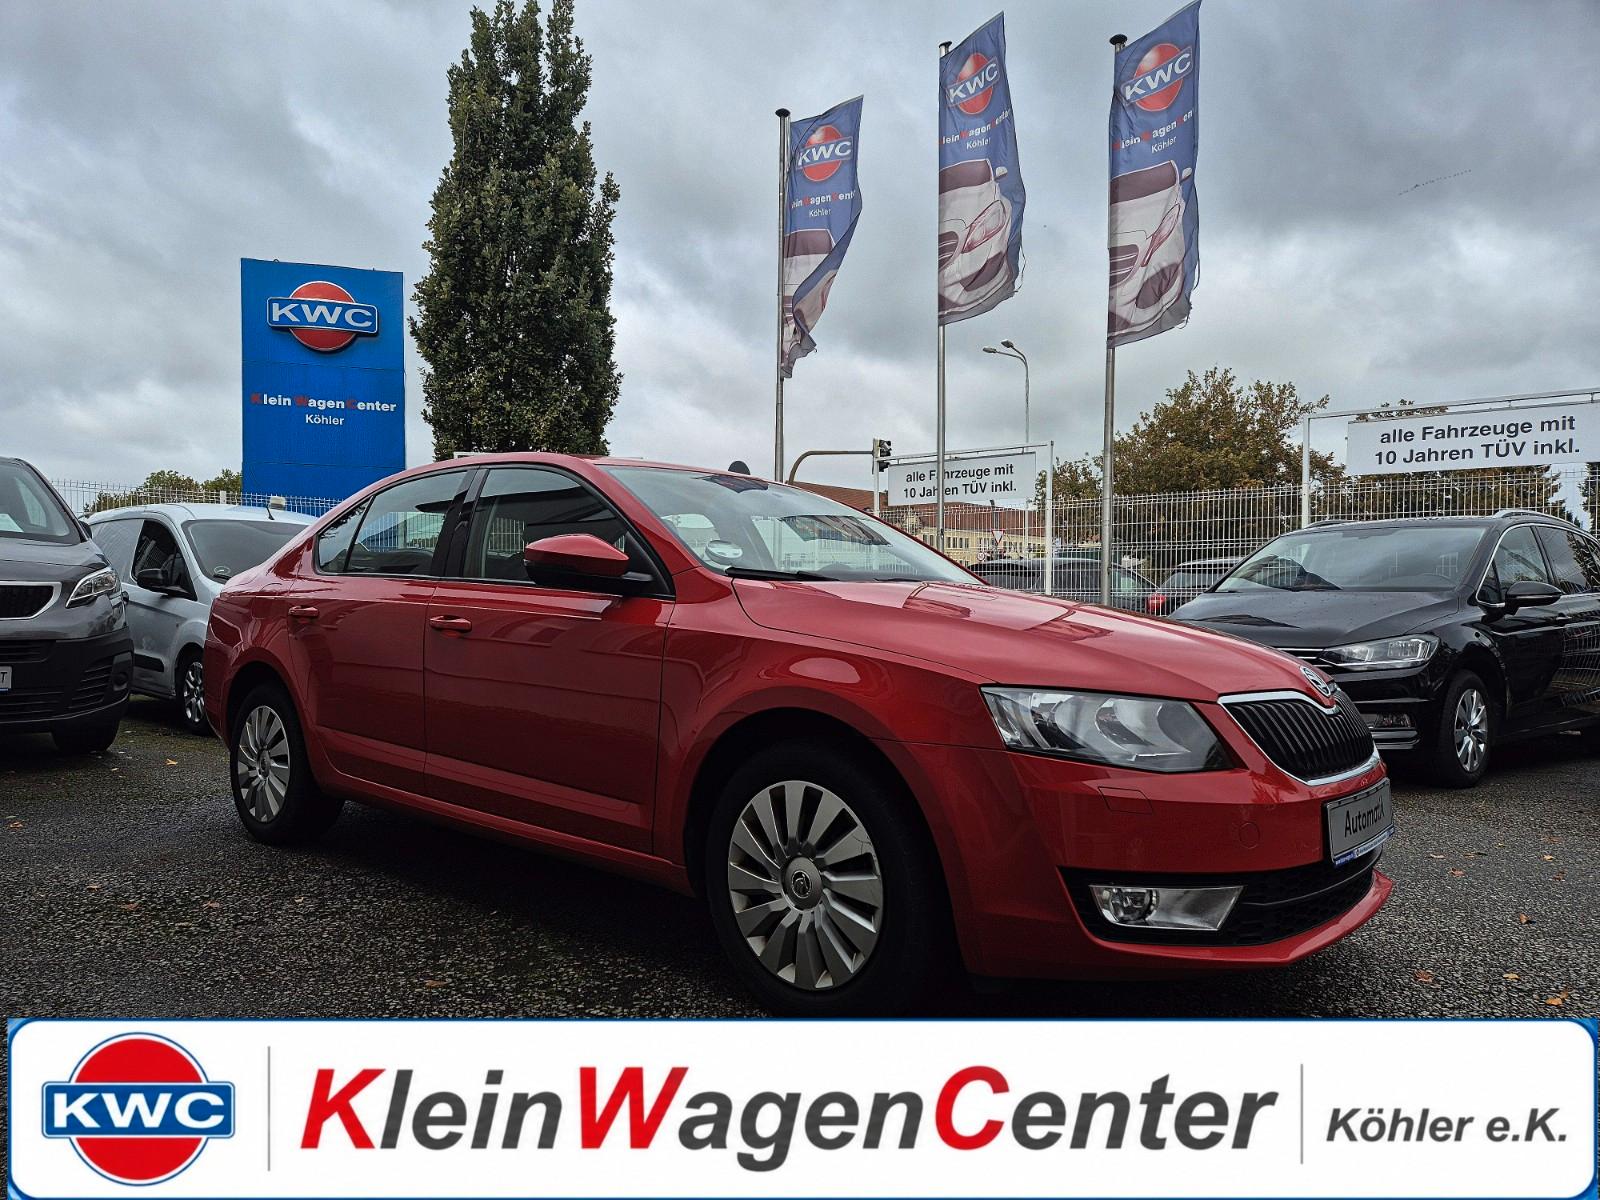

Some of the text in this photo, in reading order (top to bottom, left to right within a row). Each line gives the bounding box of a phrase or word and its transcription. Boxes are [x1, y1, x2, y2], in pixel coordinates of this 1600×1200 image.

[949, 63, 998, 103] KWC
[1125, 53, 1191, 100] KWC
[798, 141, 852, 166] KWC
[1151, 136, 1177, 153] Köhler
[272, 303, 373, 327] KWC
[305, 414, 345, 425] Köhler
[1380, 416, 1576, 443] alle Fahrzeuge mit
[1375, 438, 1580, 465] 10 Jahren TÜV inkl.
[906, 464, 1014, 482] alle Fhrzeuge mit
[903, 480, 1017, 498] 10 Jahen TÜV inkl.
